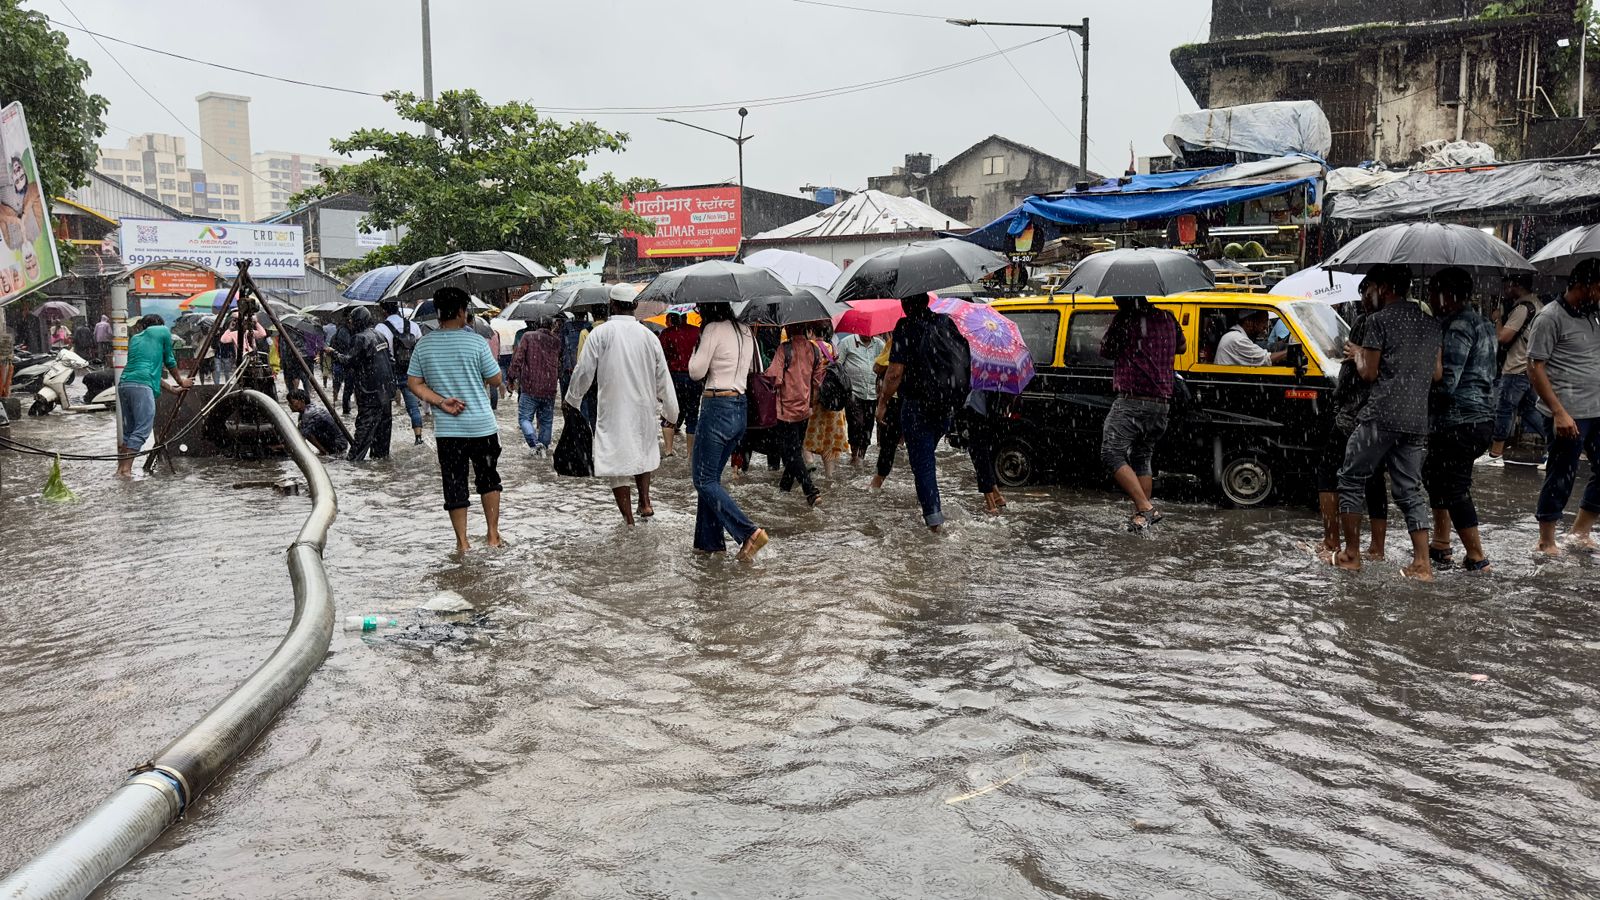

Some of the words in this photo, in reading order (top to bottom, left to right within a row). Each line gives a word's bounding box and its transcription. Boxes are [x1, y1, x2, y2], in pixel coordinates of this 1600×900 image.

[644, 225, 695, 238] ALIMAR
[697, 227, 737, 235] RESTAURANT
[215, 255, 221, 268] /
[225, 257, 261, 267] 9833
[264, 258, 300, 268] 44444
